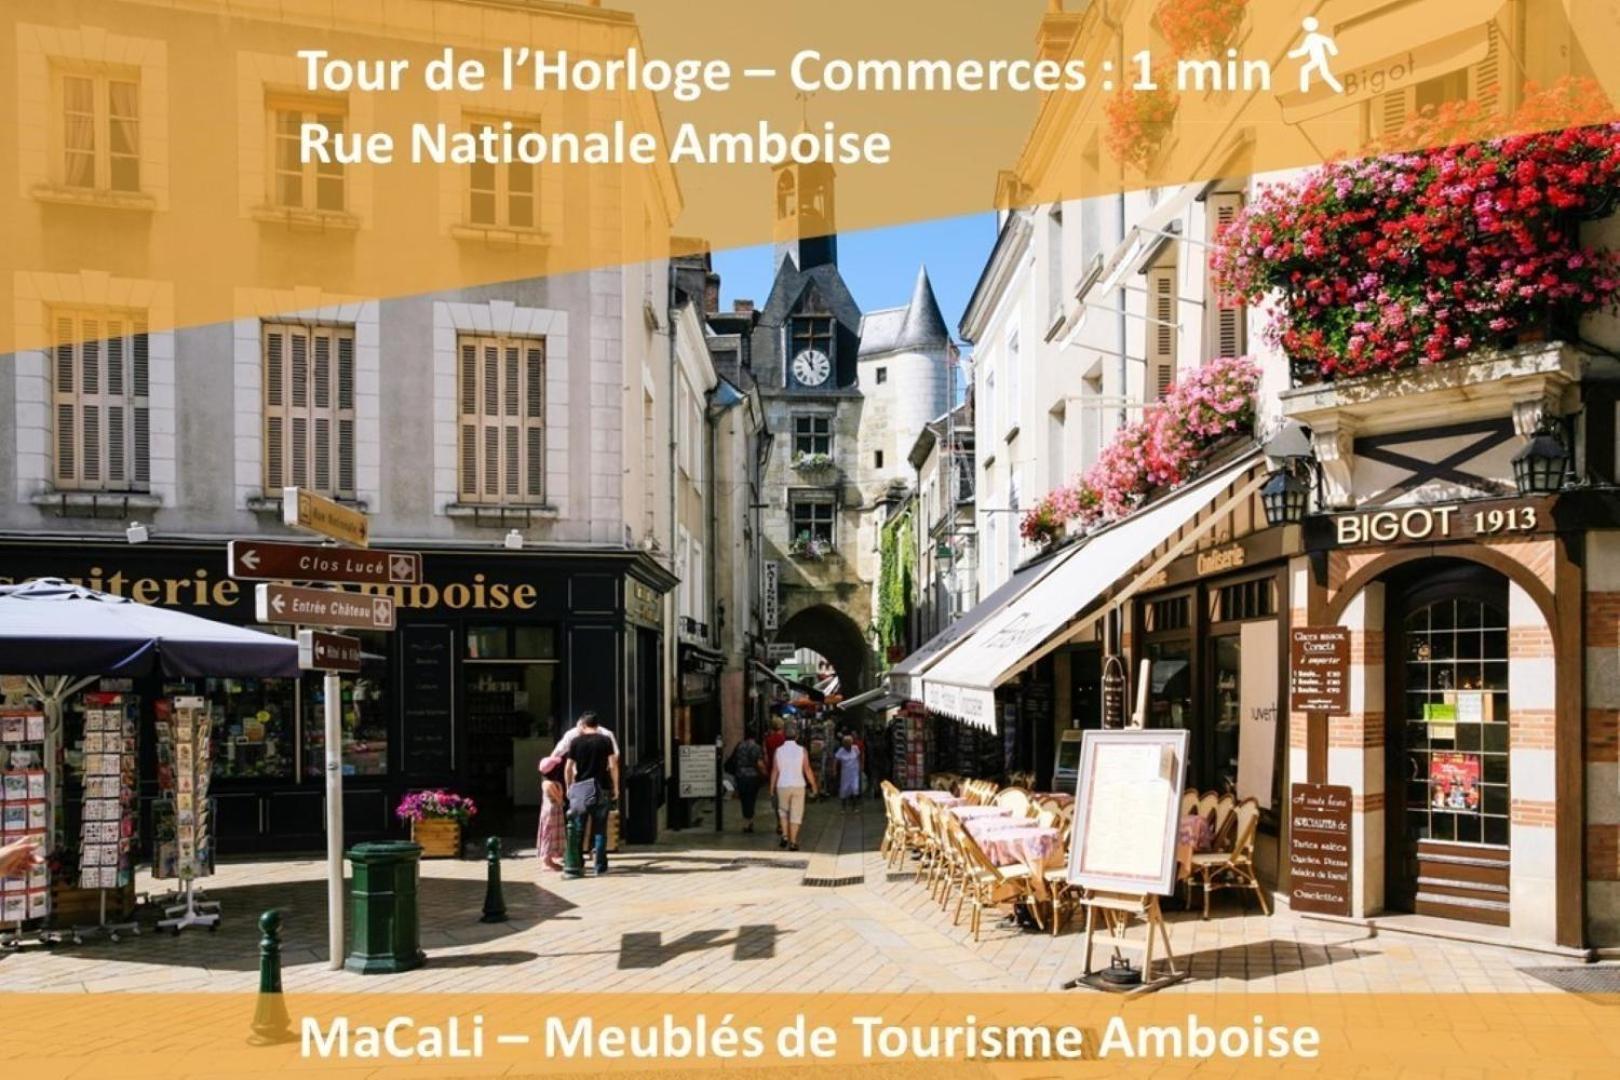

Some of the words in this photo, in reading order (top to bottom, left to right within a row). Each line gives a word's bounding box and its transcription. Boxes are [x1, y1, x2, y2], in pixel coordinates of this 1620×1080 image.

[1344, 52, 1415, 97] Bigot
[1336, 505, 1459, 545] BIGOT
[1473, 506, 1538, 534] 1913
[299, 556, 339, 572] Clos
[346, 559, 385, 574] Lucé
[292, 598, 327, 615] Entrée
[330, 601, 371, 618] Château
